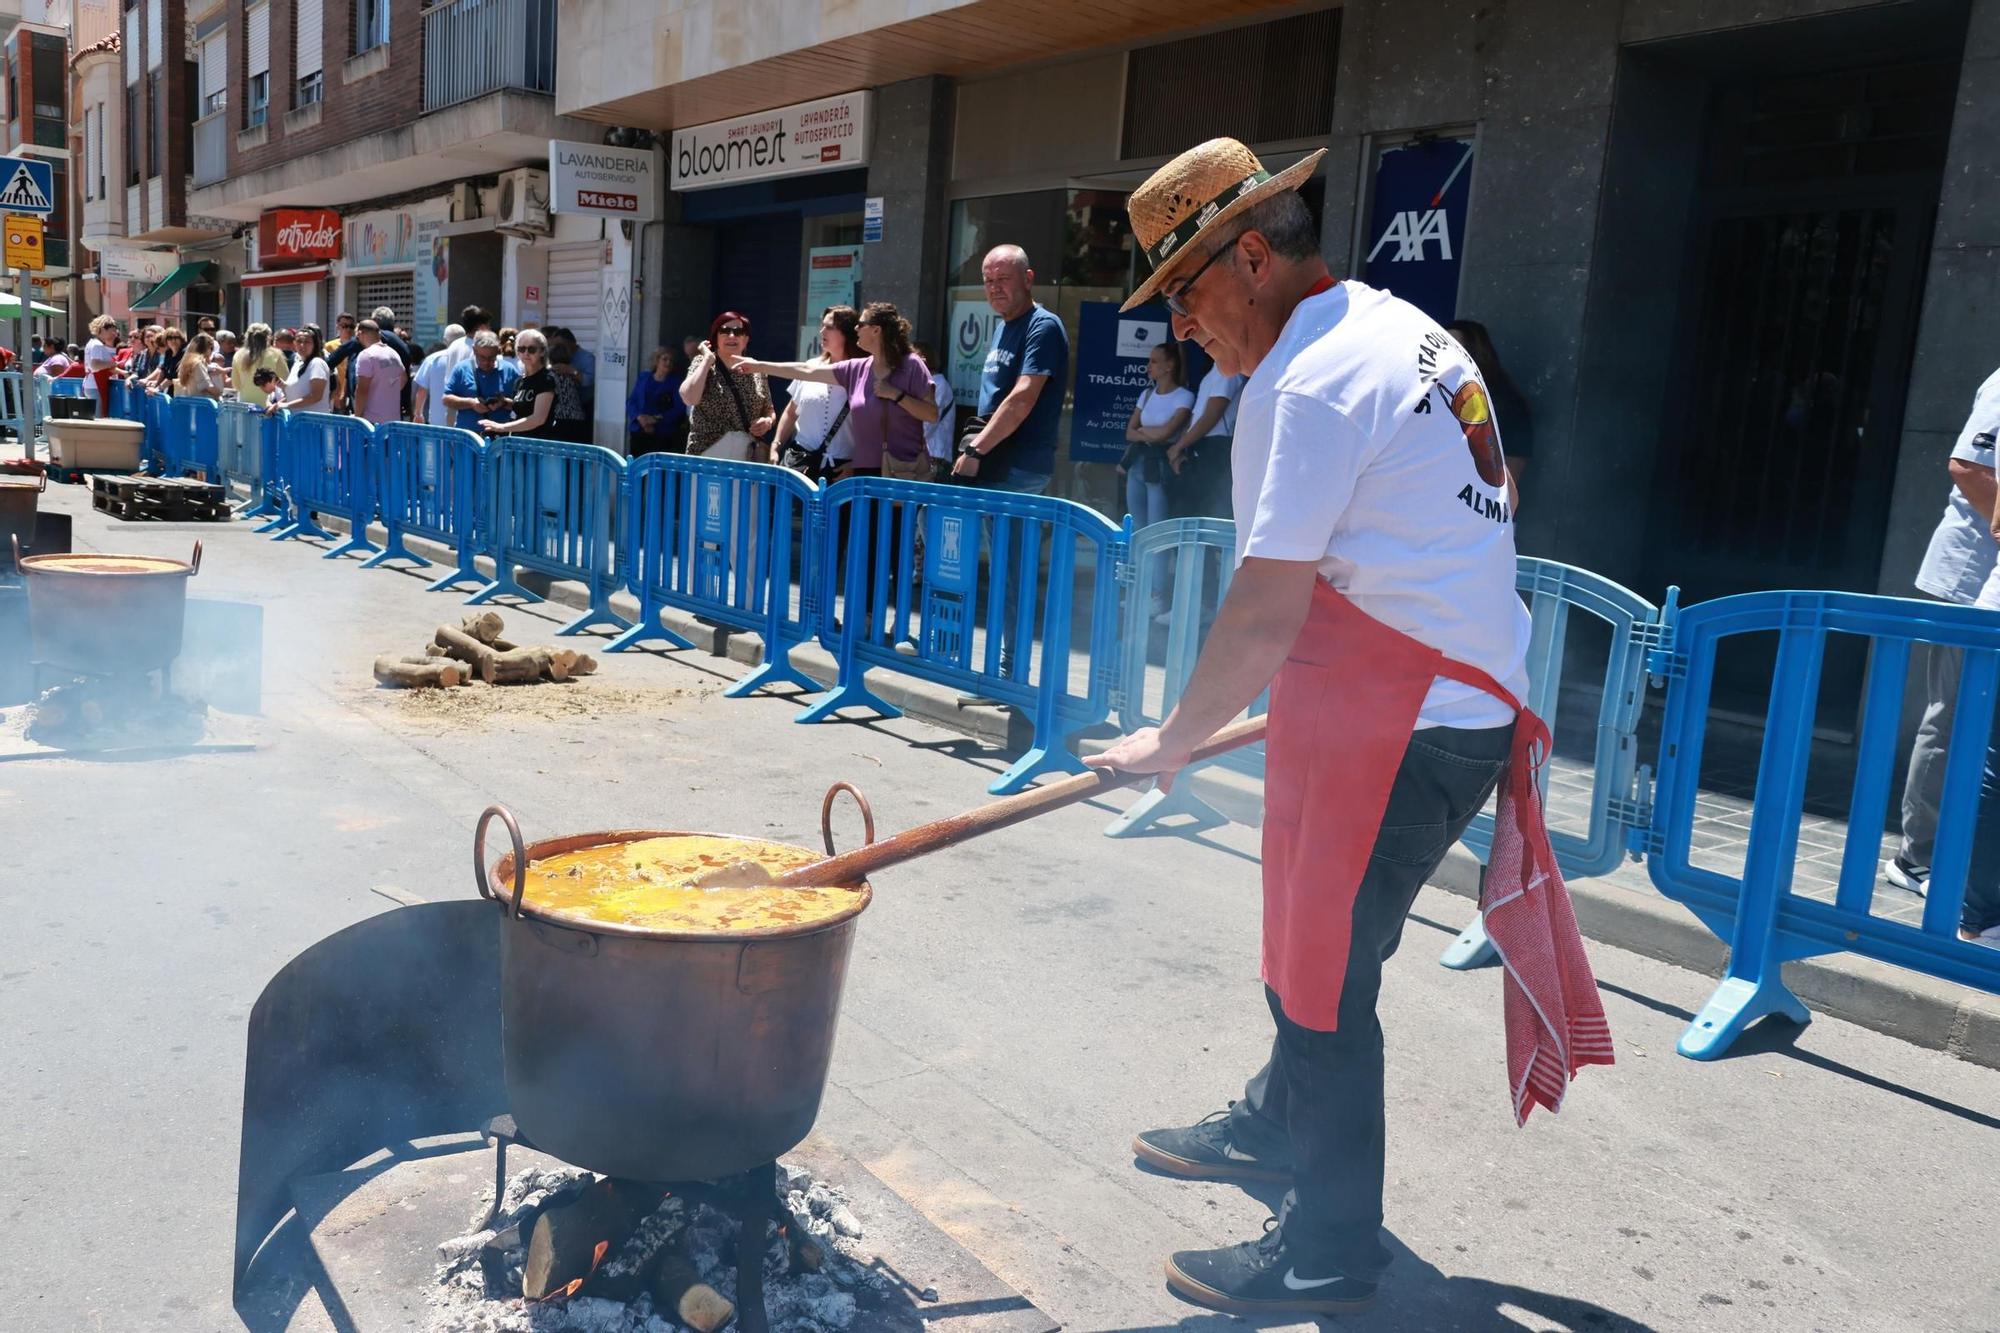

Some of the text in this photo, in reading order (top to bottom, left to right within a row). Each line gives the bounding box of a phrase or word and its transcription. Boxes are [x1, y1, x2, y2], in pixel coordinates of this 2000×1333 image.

[800, 99, 851, 127] LAVANDERÍA
[728, 119, 779, 139] SMART LAUNDRY
[794, 122, 854, 145] AUTOSERVICIO
[679, 118, 787, 178] bloomest
[559, 151, 649, 173] LAVANDERÍA
[574, 170, 636, 184] AUTOSERVICIO
[579, 192, 636, 209] Miele
[277, 214, 342, 253] entredos
[1366, 208, 1453, 263] AXA
[1088, 374, 1155, 387] TRASLADA
[1124, 364, 1148, 375] ¡NO
